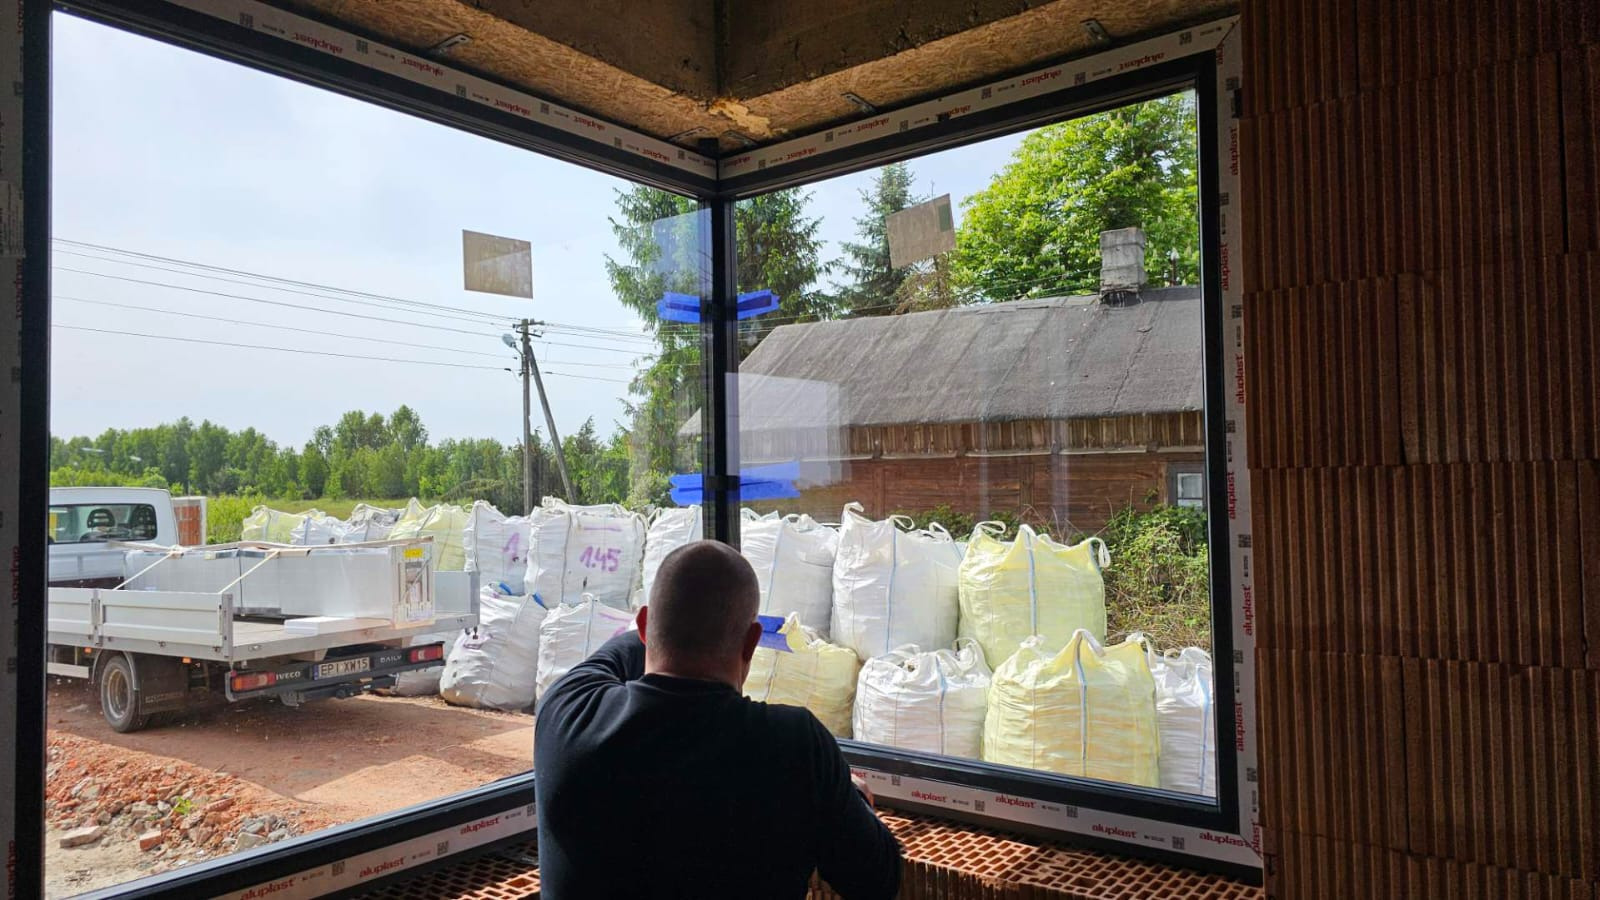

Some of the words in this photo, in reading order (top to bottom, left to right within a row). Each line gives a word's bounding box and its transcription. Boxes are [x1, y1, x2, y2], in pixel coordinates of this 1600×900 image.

[294, 32, 343, 54] aluplast
[401, 57, 444, 77] aluplast
[1119, 52, 1165, 71] aluplast
[1020, 69, 1062, 87] aluplast
[494, 99, 531, 116] aluplast
[573, 114, 605, 131] aluplast
[857, 117, 890, 132] aluplast
[1230, 128, 1238, 176] aluplast
[1220, 242, 1230, 291] aluplast
[1235, 354, 1245, 405] aluplast
[1227, 471, 1237, 520] aluplast
[579, 546, 622, 572] 1.45
[1243, 584, 1254, 636] aluplast
[343, 658, 368, 673] XW15
[380, 655, 402, 663] DAILY
[275, 671, 301, 681] IVECO
[1235, 702, 1245, 752] aluplast
[911, 789, 947, 803] aluplast
[995, 794, 1036, 809] aluplast
[459, 816, 501, 835] aluplast
[1092, 824, 1137, 839] aluplast
[358, 855, 406, 879] aluplast
[240, 875, 297, 900] aluplast
